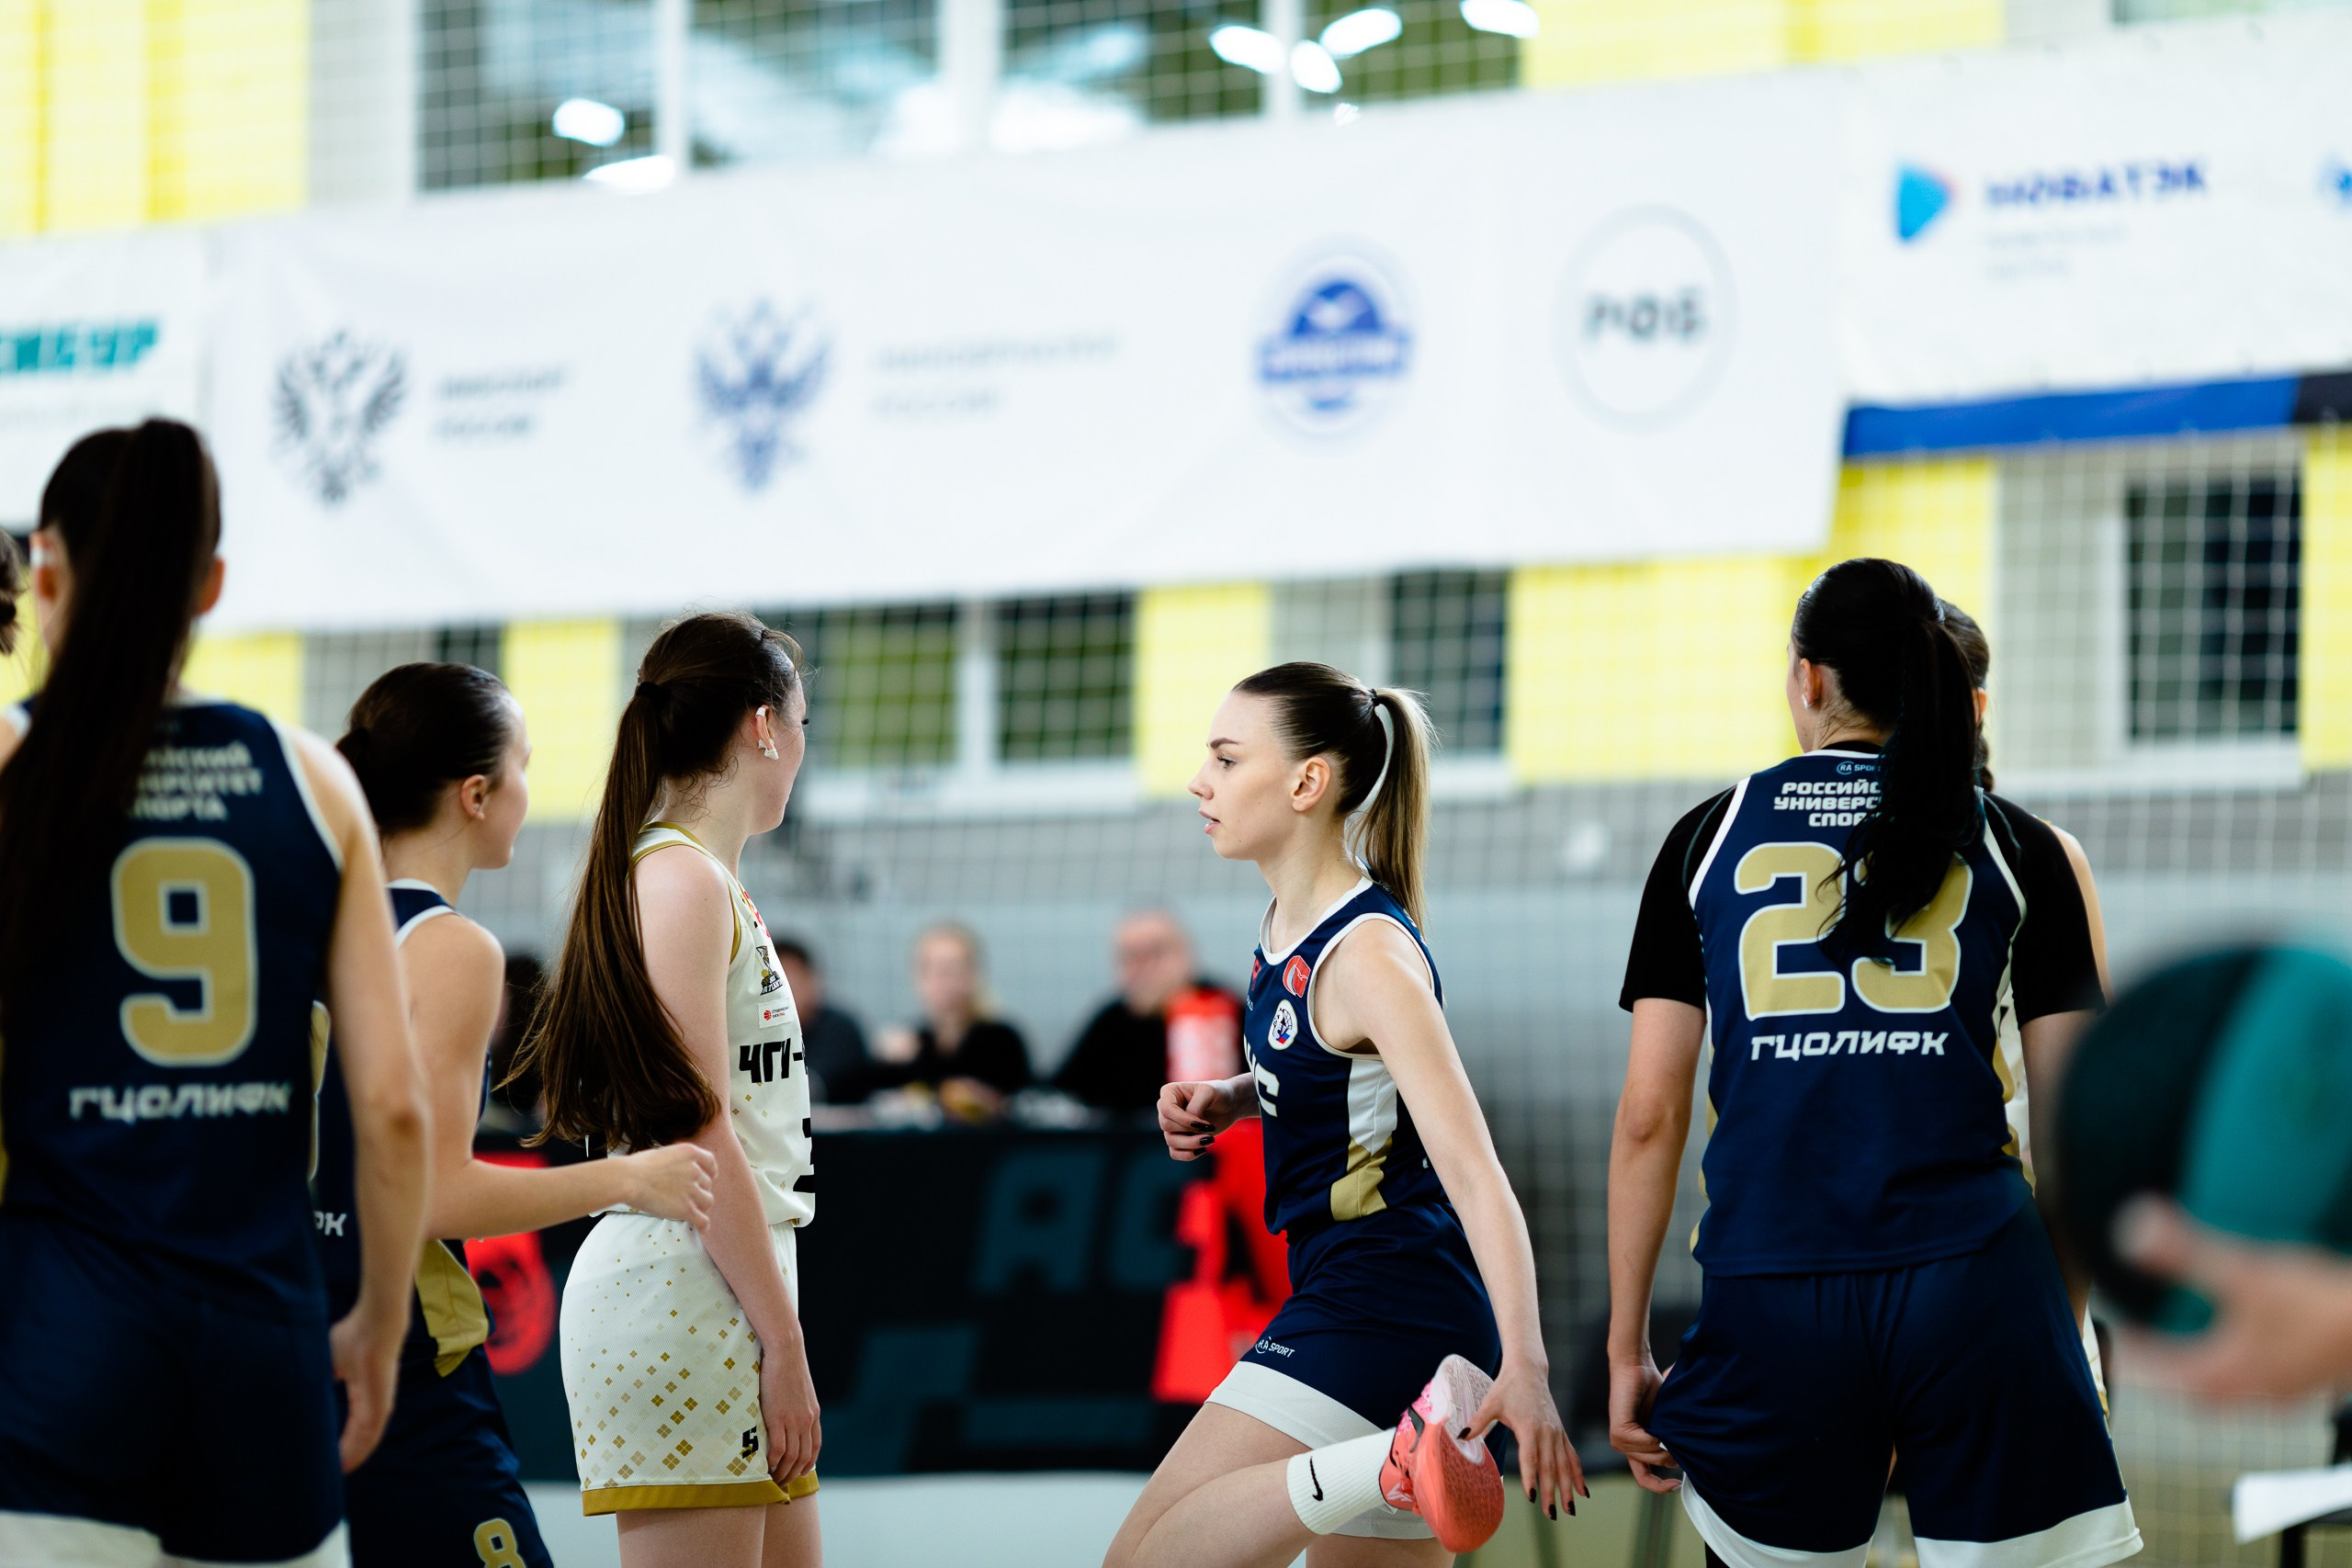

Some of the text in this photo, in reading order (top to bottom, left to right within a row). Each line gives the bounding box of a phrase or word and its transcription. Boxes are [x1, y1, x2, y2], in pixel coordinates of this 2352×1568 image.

[1781, 779, 1882, 795] РОССИЙС
[1774, 796, 1880, 810] УНИВЕРС
[1734, 841, 1973, 1021] 23
[111, 838, 257, 1066] 9
[1751, 1031, 1950, 1062] ГЦОЛИФК
[1269, 1342, 1295, 1358] SPORT
[742, 1425, 760, 1459] 5
